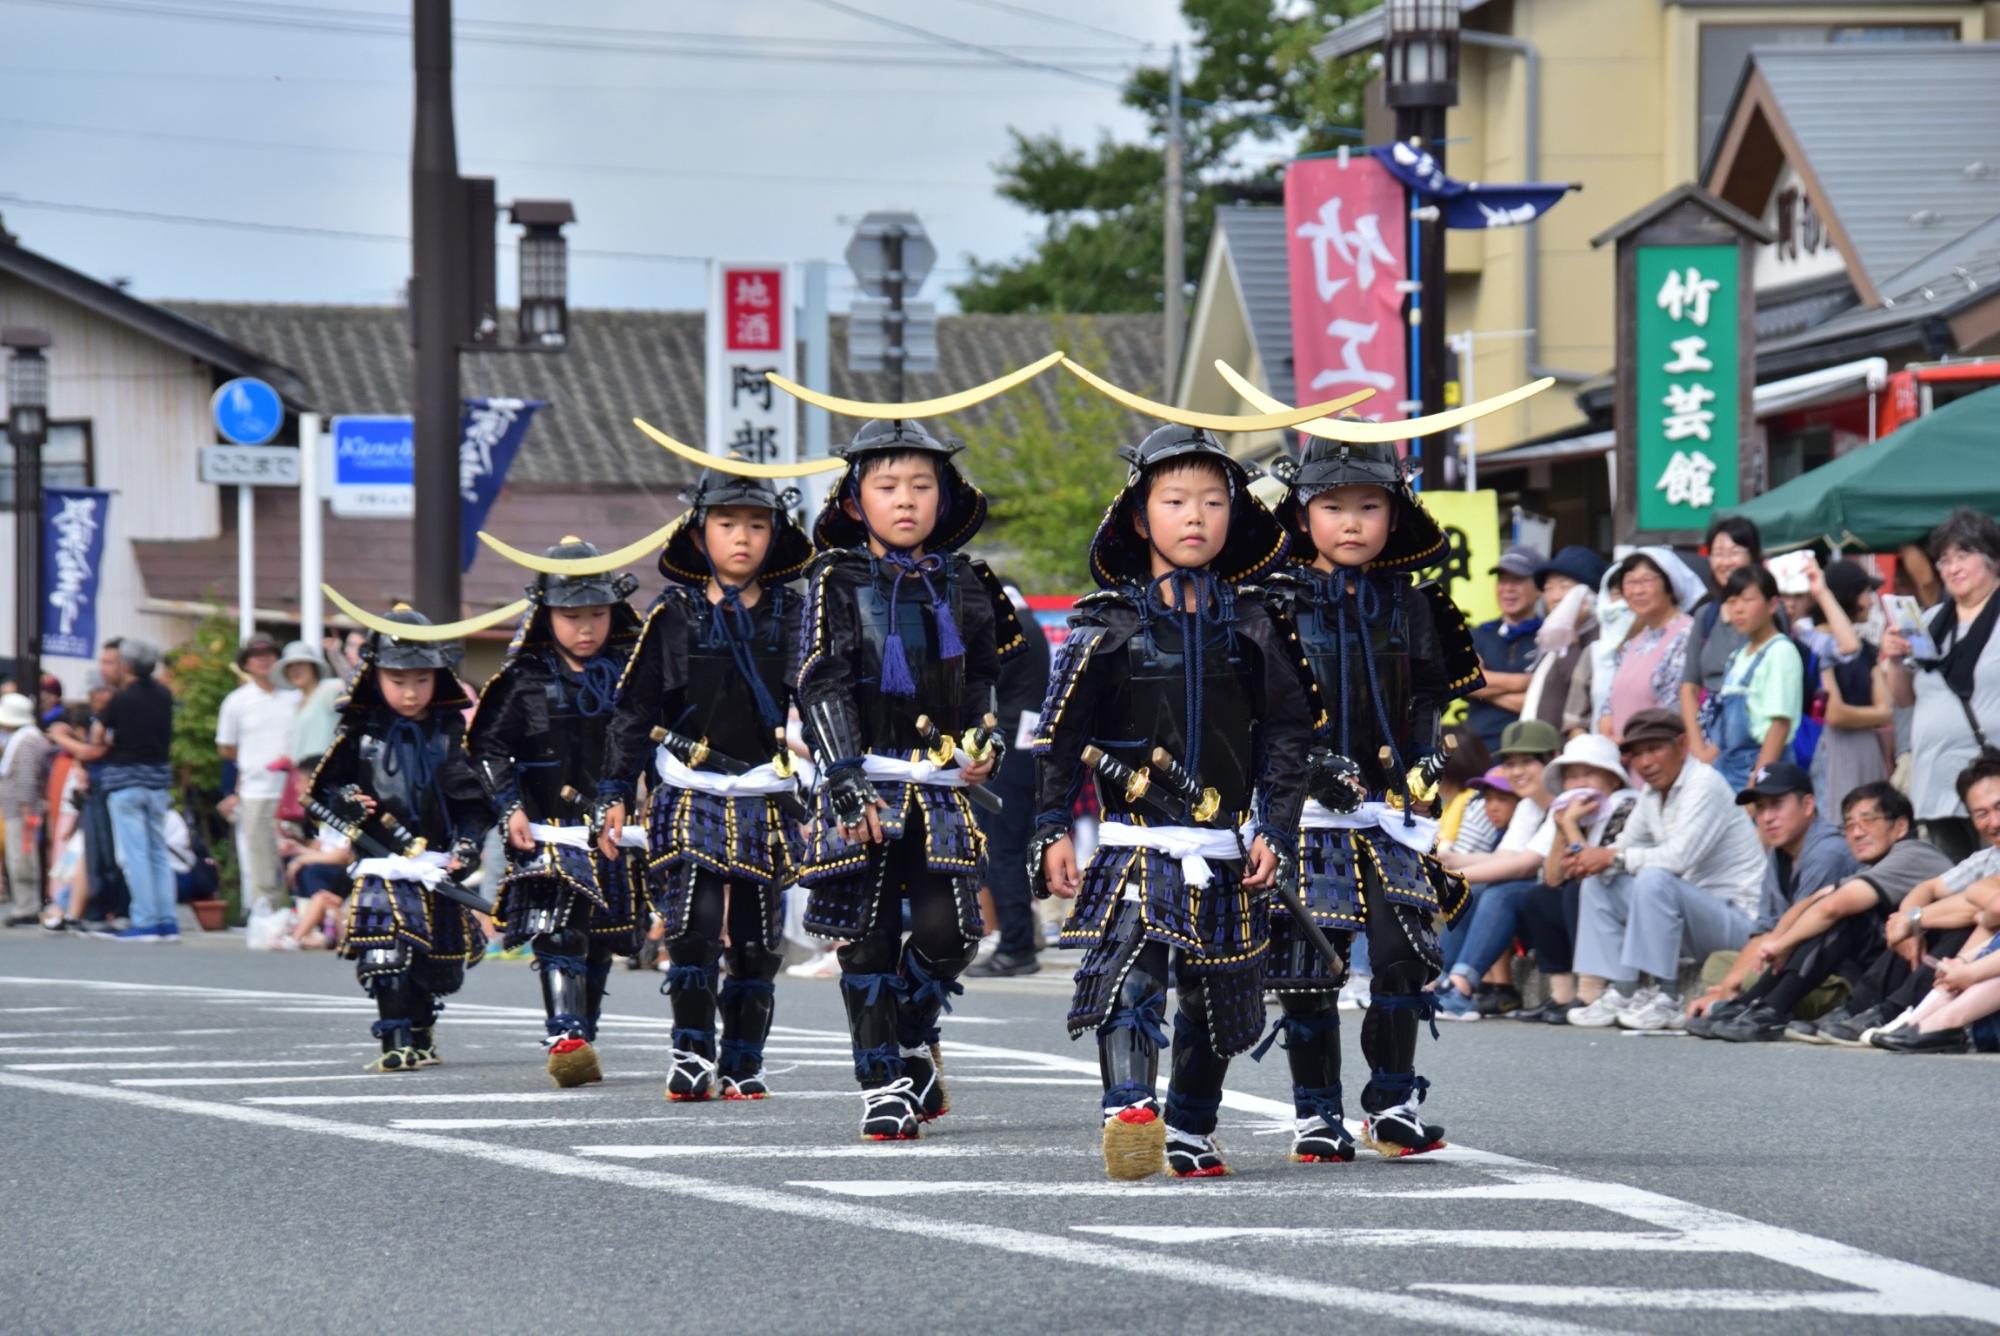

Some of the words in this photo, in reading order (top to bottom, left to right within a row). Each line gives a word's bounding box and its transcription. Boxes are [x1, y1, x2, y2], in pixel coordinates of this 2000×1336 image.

[734, 277, 772, 346] 地酒
[1656, 267, 1721, 509] 竹工芸館
[210, 453, 294, 477] ここまで
